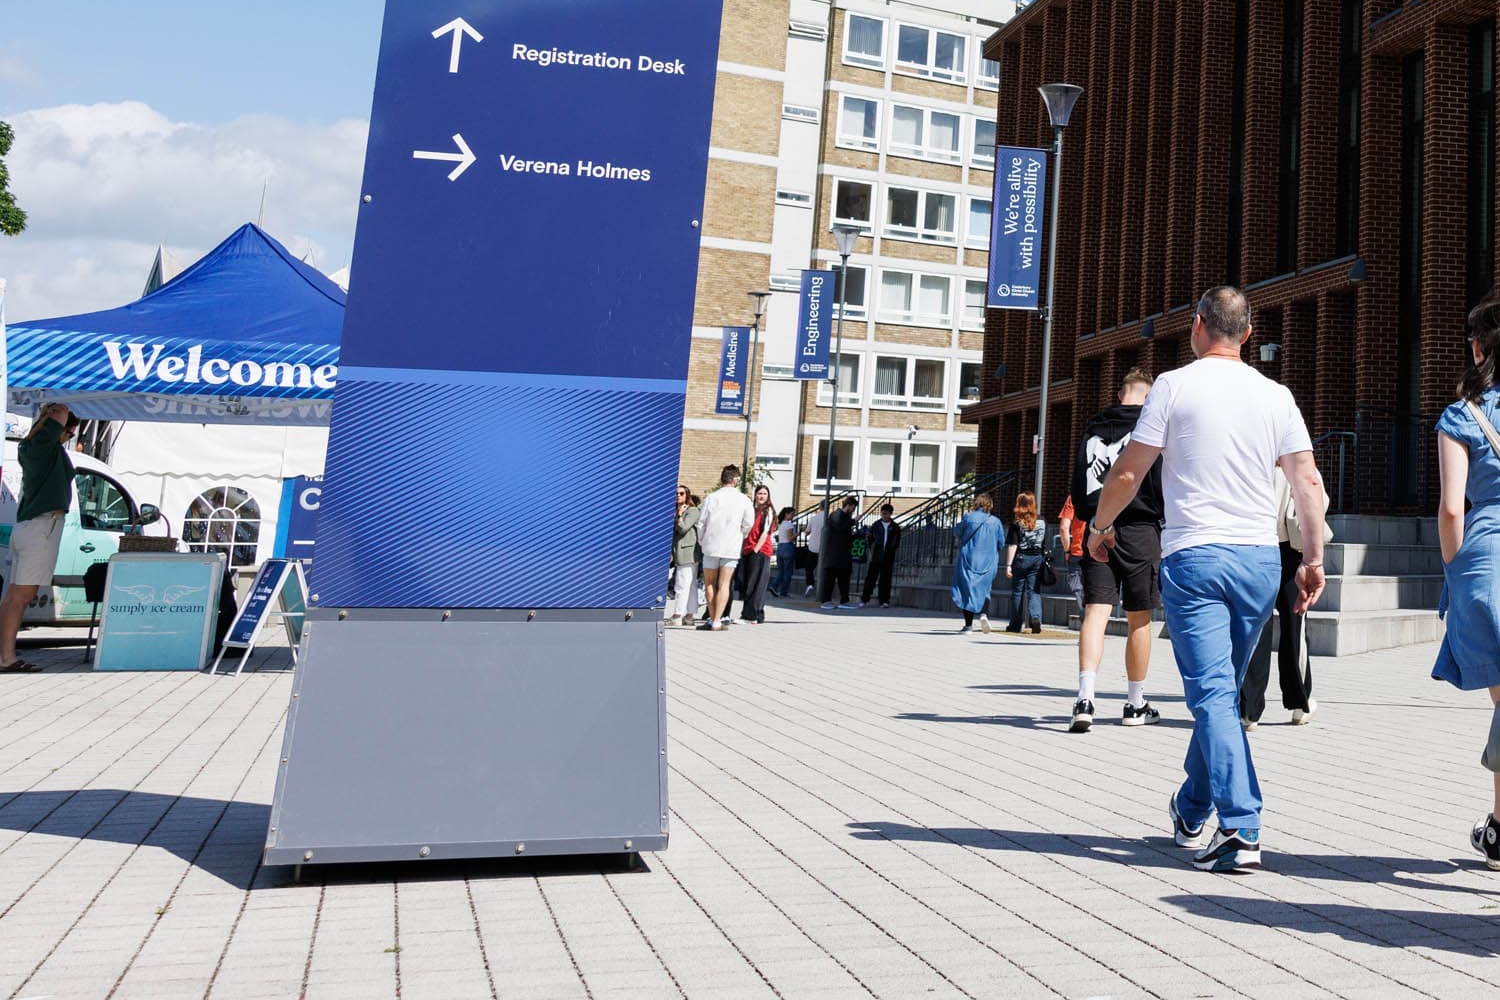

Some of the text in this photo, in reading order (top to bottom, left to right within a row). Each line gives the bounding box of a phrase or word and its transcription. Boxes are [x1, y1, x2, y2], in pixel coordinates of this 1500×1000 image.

[512, 43, 685, 75] Registration Desk
[499, 154, 651, 182] Verena Holmes
[1007, 157, 1022, 190] alive
[1019, 158, 1041, 269] with possibility
[803, 276, 824, 356] Engineering
[102, 341, 338, 389] Welcome
[725, 331, 738, 377] Medicine
[110, 602, 204, 615] simply ice cream
